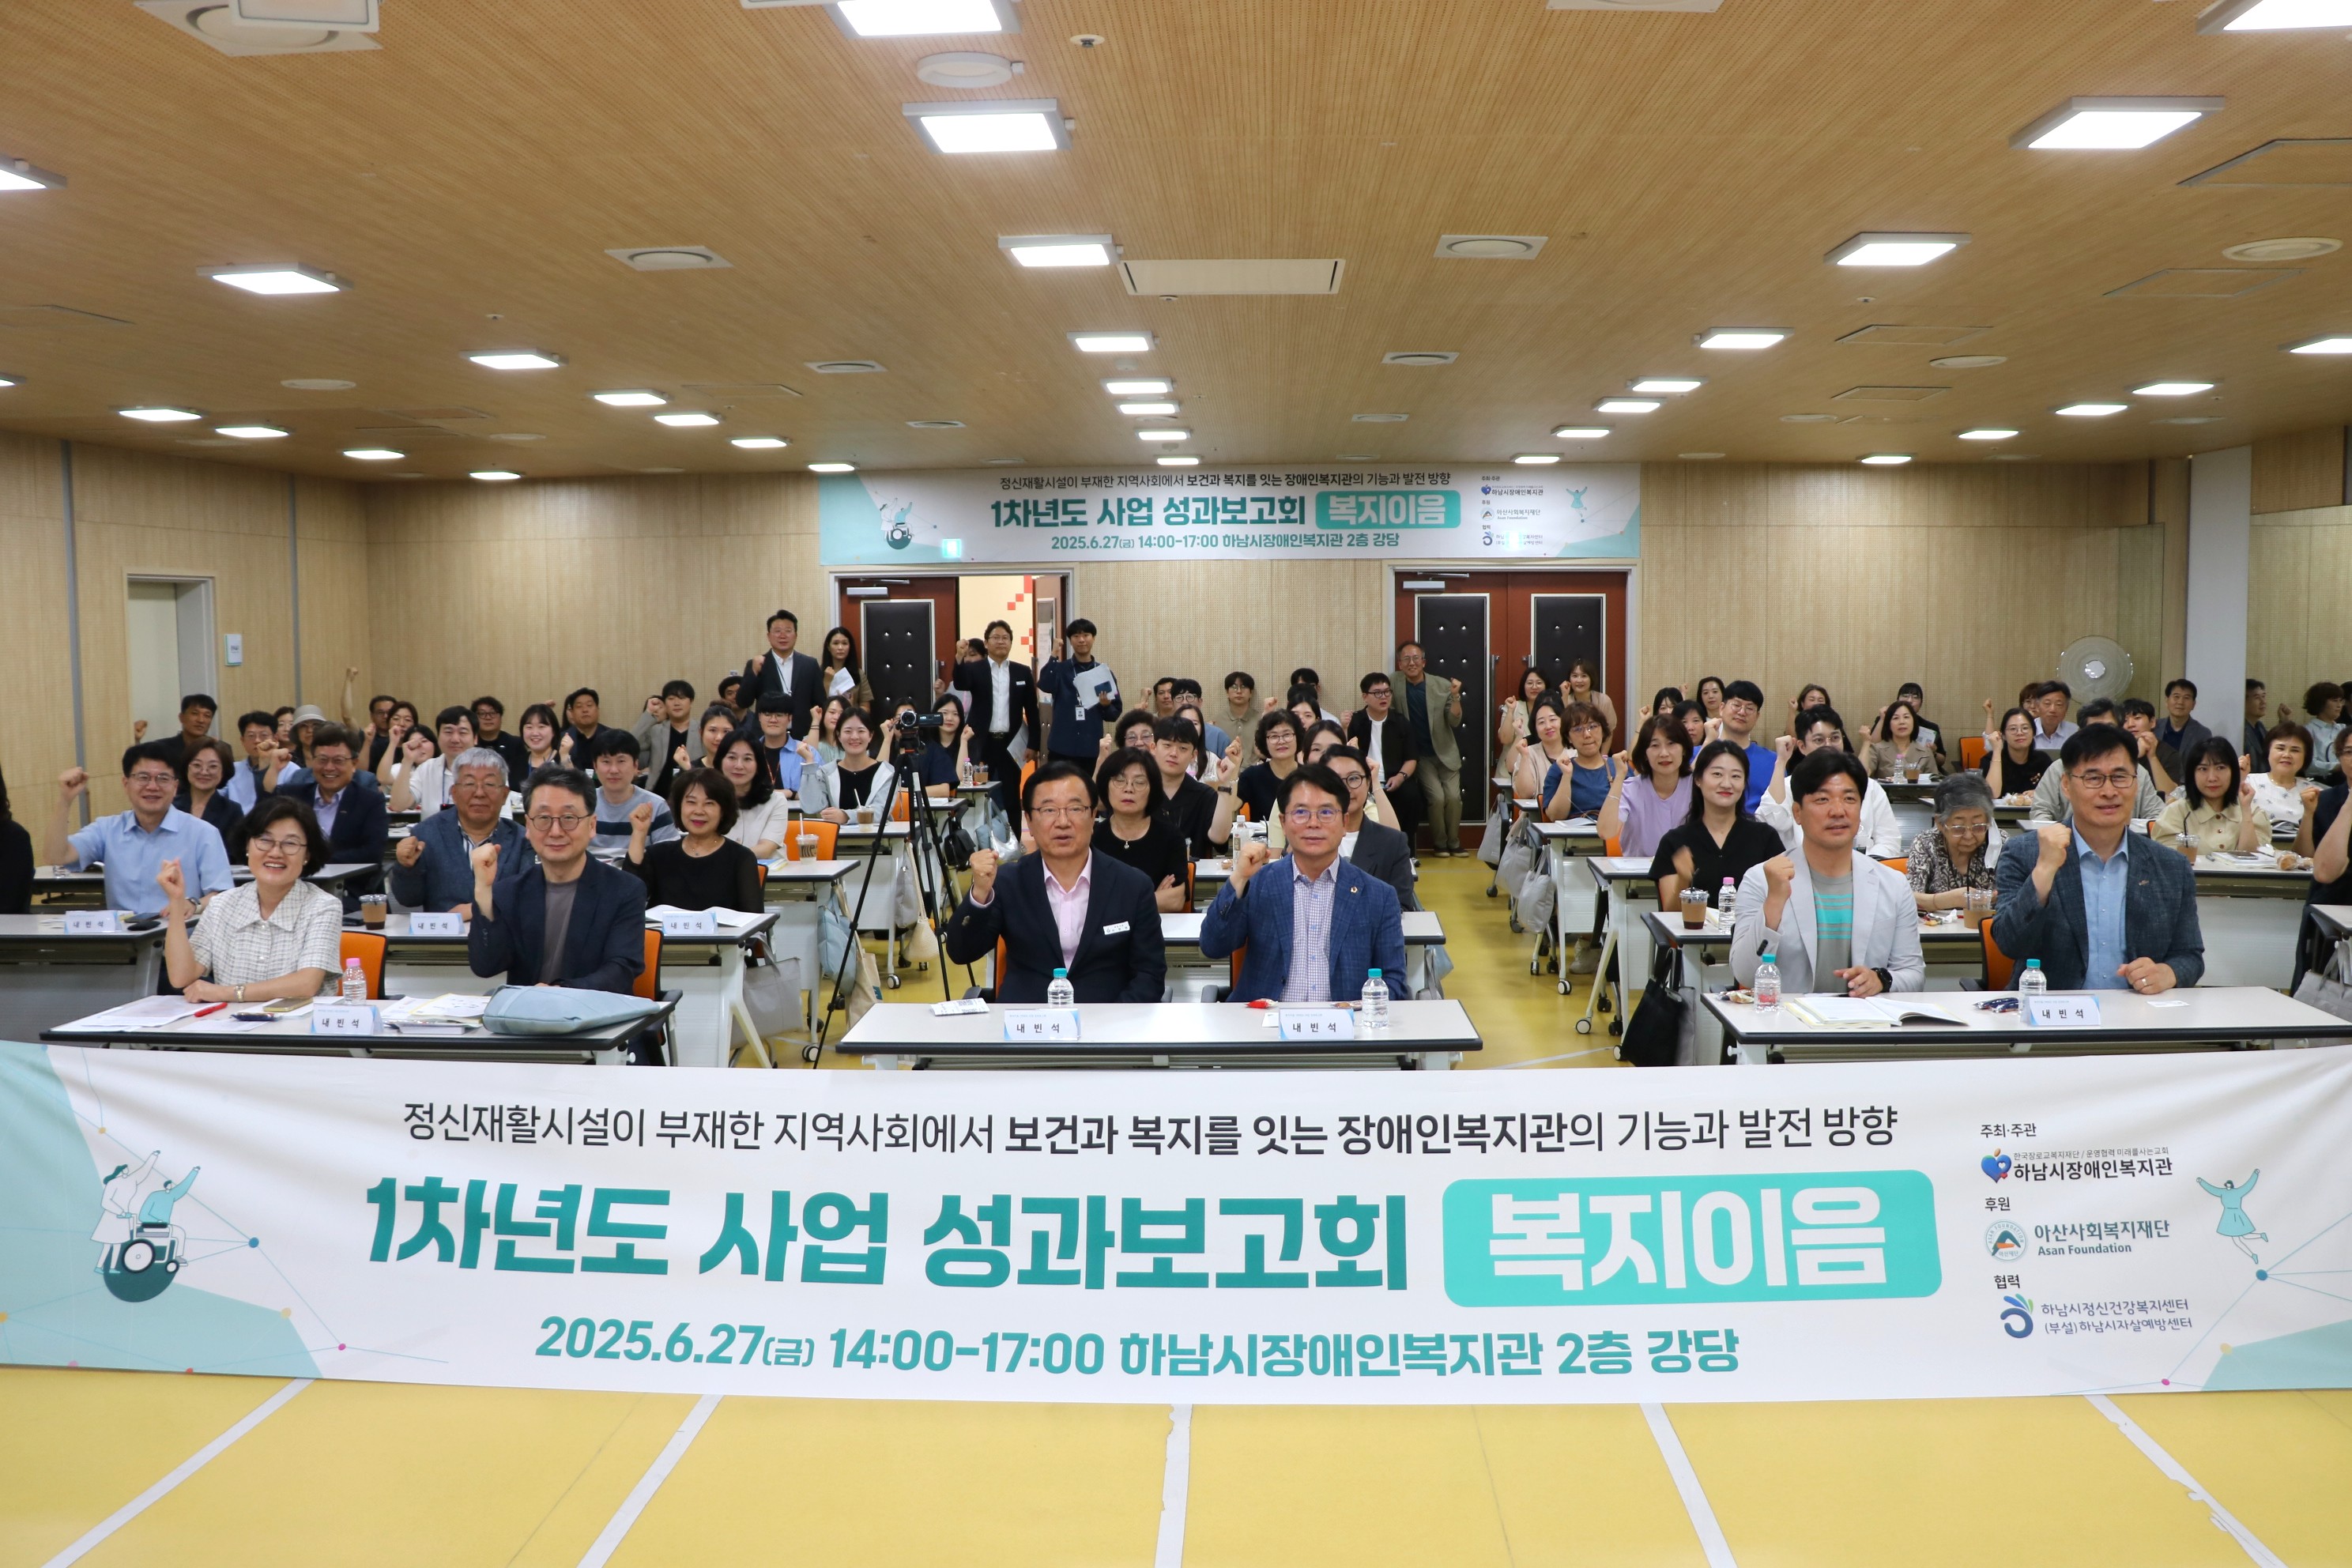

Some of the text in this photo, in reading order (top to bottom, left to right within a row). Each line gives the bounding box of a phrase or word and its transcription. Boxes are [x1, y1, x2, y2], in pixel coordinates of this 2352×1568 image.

[1001, 473, 1451, 489] 정신재활시설이 부재한 지역사회에서 보건과 복지를 잇는 장애인복지관의 기능과 발전 방향
[991, 496, 1305, 527] 1차년도 사업 성과보고회
[1329, 494, 1446, 525] 복지이음
[1052, 533, 1400, 549] 2025.6.27(금) 14:00-17:00 하남시장애인복지관 2층 강당
[404, 1103, 1898, 1155] 정신재활시설이 부재한 지역사회에서 보건과 복지를 잇는 장애인복지관의 기능과 발전 방향
[1980, 1122, 2037, 1138] 주최·주관
[2086, 1149, 2115, 1158] 운영협력
[2014, 1158, 2173, 1182] 하남시장애인복지관
[1984, 1197, 2011, 1212] 후원
[367, 1177, 1408, 1291] 1차년도 사업 성과보고회
[1489, 1186, 1886, 1291] 복지이음
[2034, 1219, 2170, 1242] 아산사회복지재단
[2037, 1242, 2132, 1256] Asan Foundation
[1993, 1274, 2021, 1289] 협력
[2041, 1298, 2189, 1317] 하남시정신건강복지센터
[535, 1315, 1740, 1378] 2025.6.27(금) 14:00-17:00 하남시장애인복지관 2층 강당
